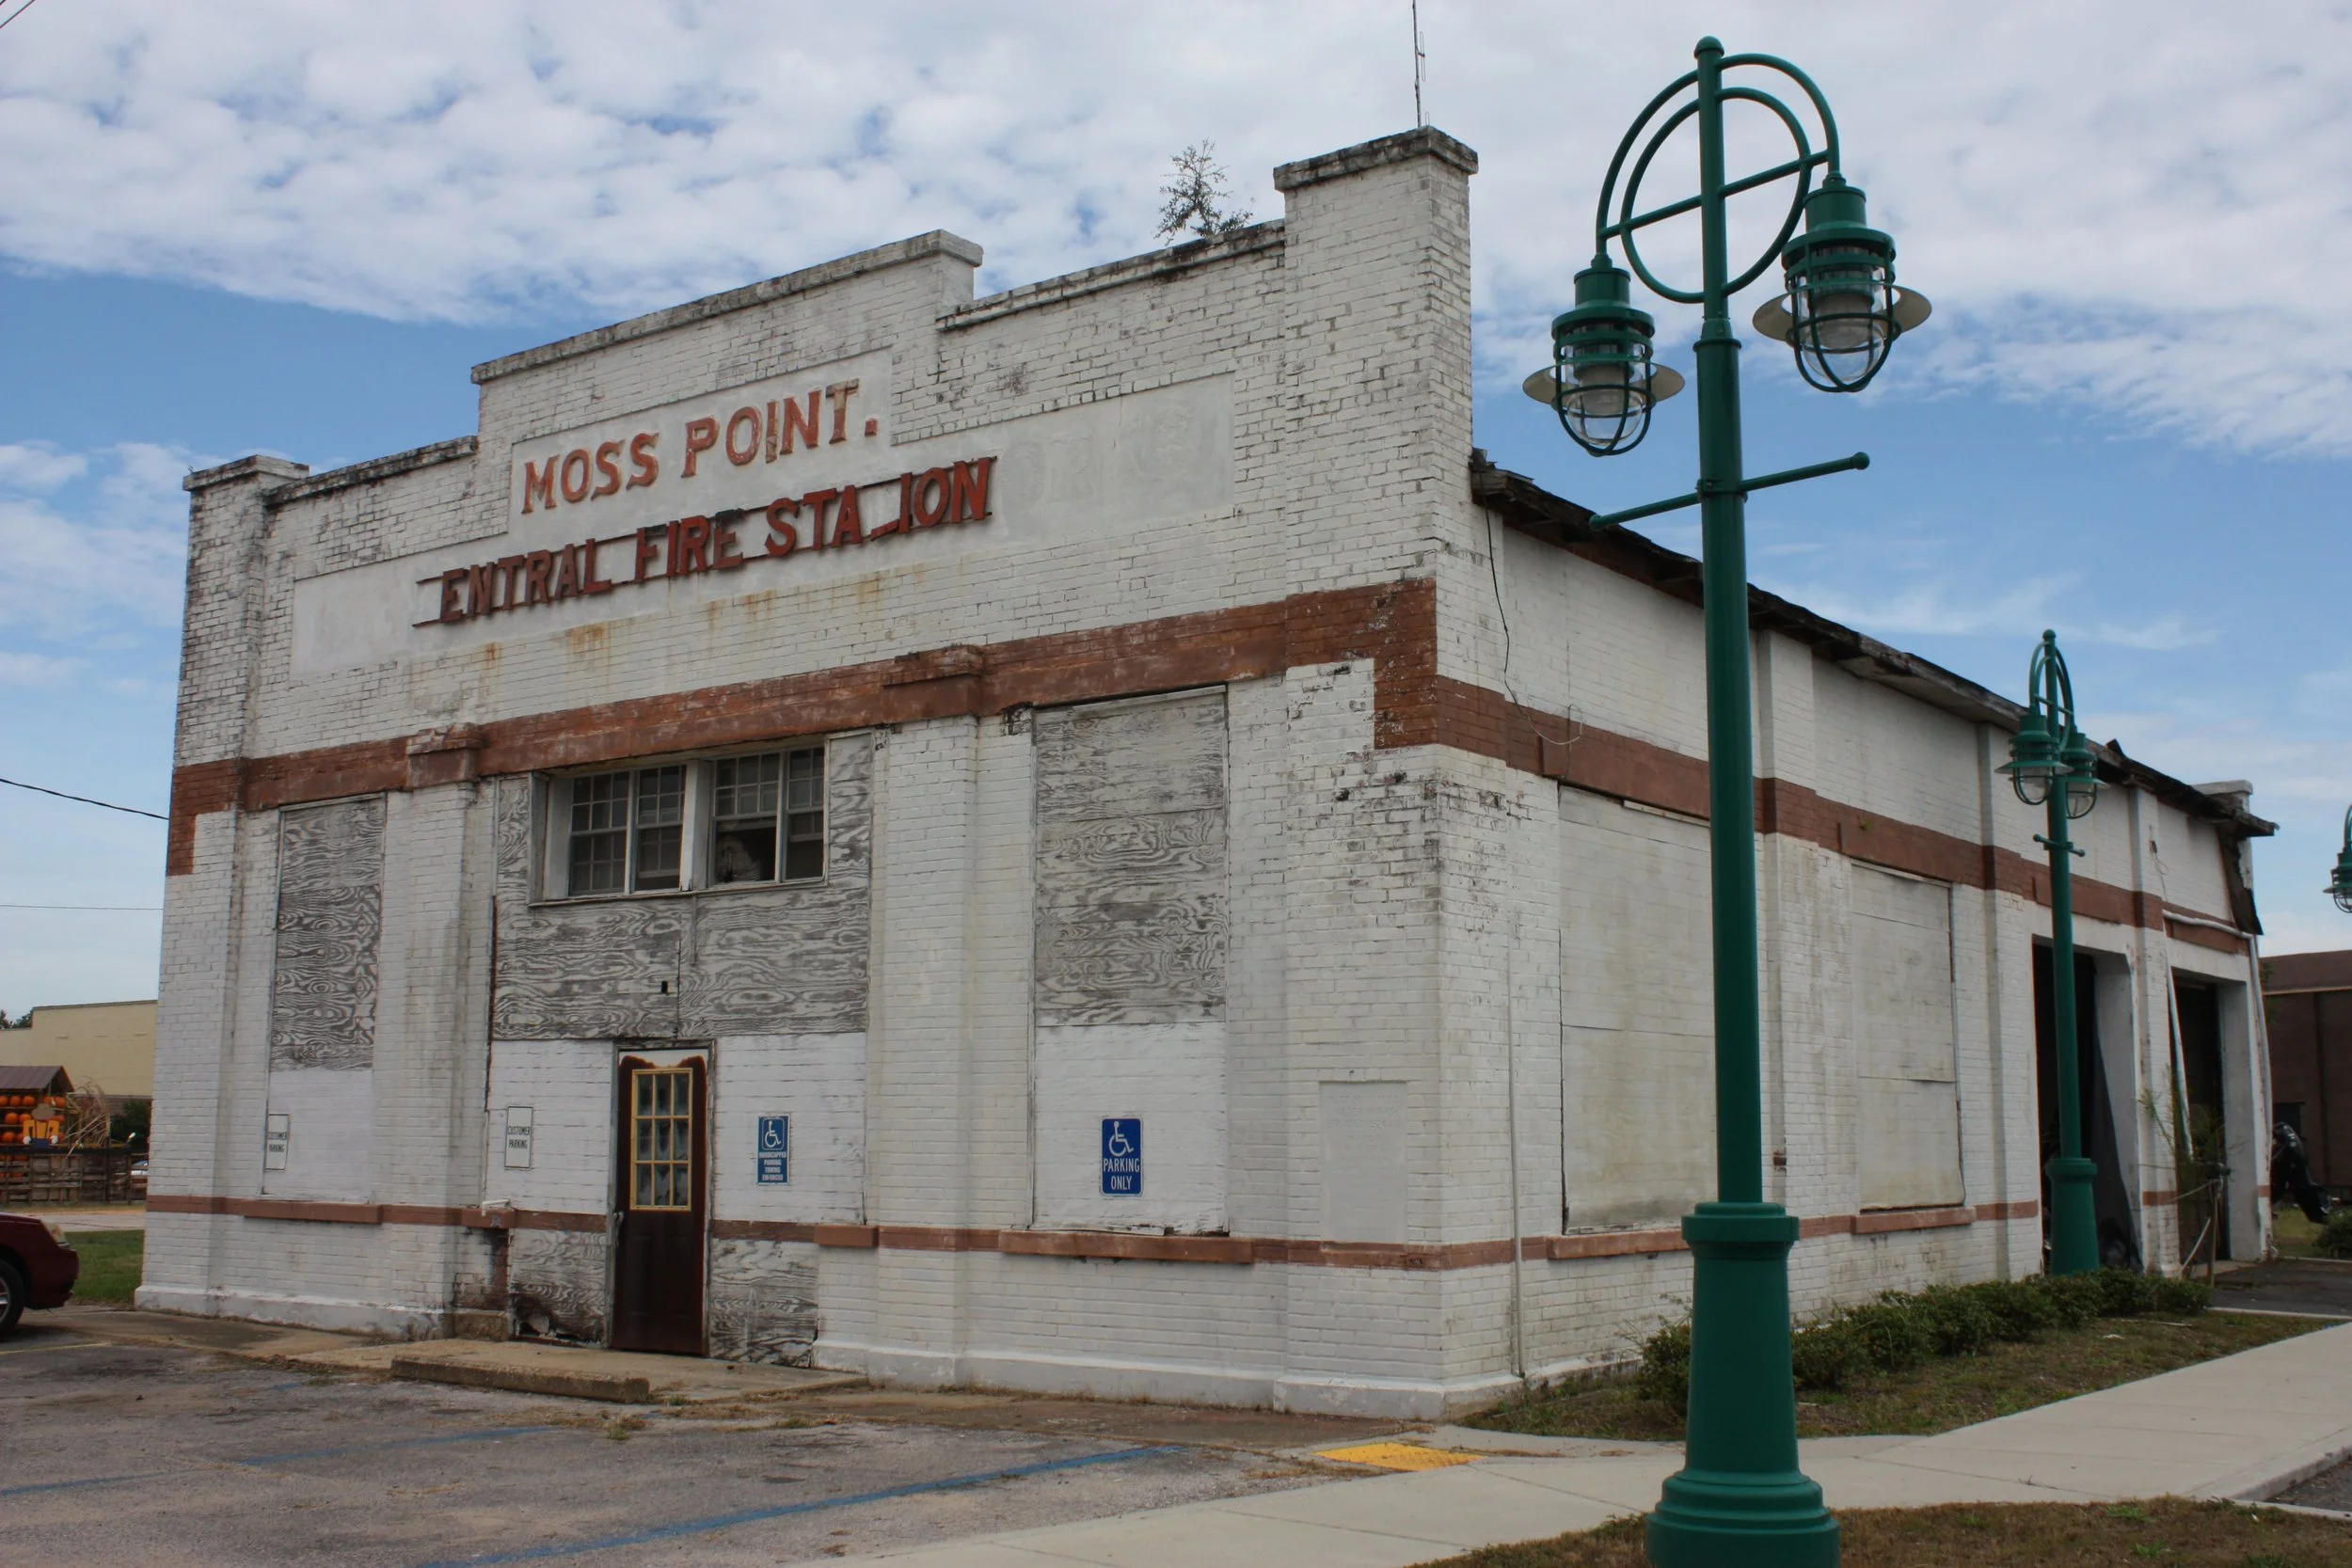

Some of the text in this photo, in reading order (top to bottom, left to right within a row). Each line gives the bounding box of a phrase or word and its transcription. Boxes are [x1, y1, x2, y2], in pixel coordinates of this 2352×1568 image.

[521, 378, 878, 515] MOSS POINT.
[439, 538, 612, 624] ENTRAL
[635, 509, 744, 585] FIRE
[764, 457, 993, 557] STAION
[507, 1125, 531, 1135] CUSTOMER
[508, 1139, 528, 1148] PARKING
[1103, 1158, 1140, 1173] PARKING
[1110, 1176, 1133, 1190] ONLY
